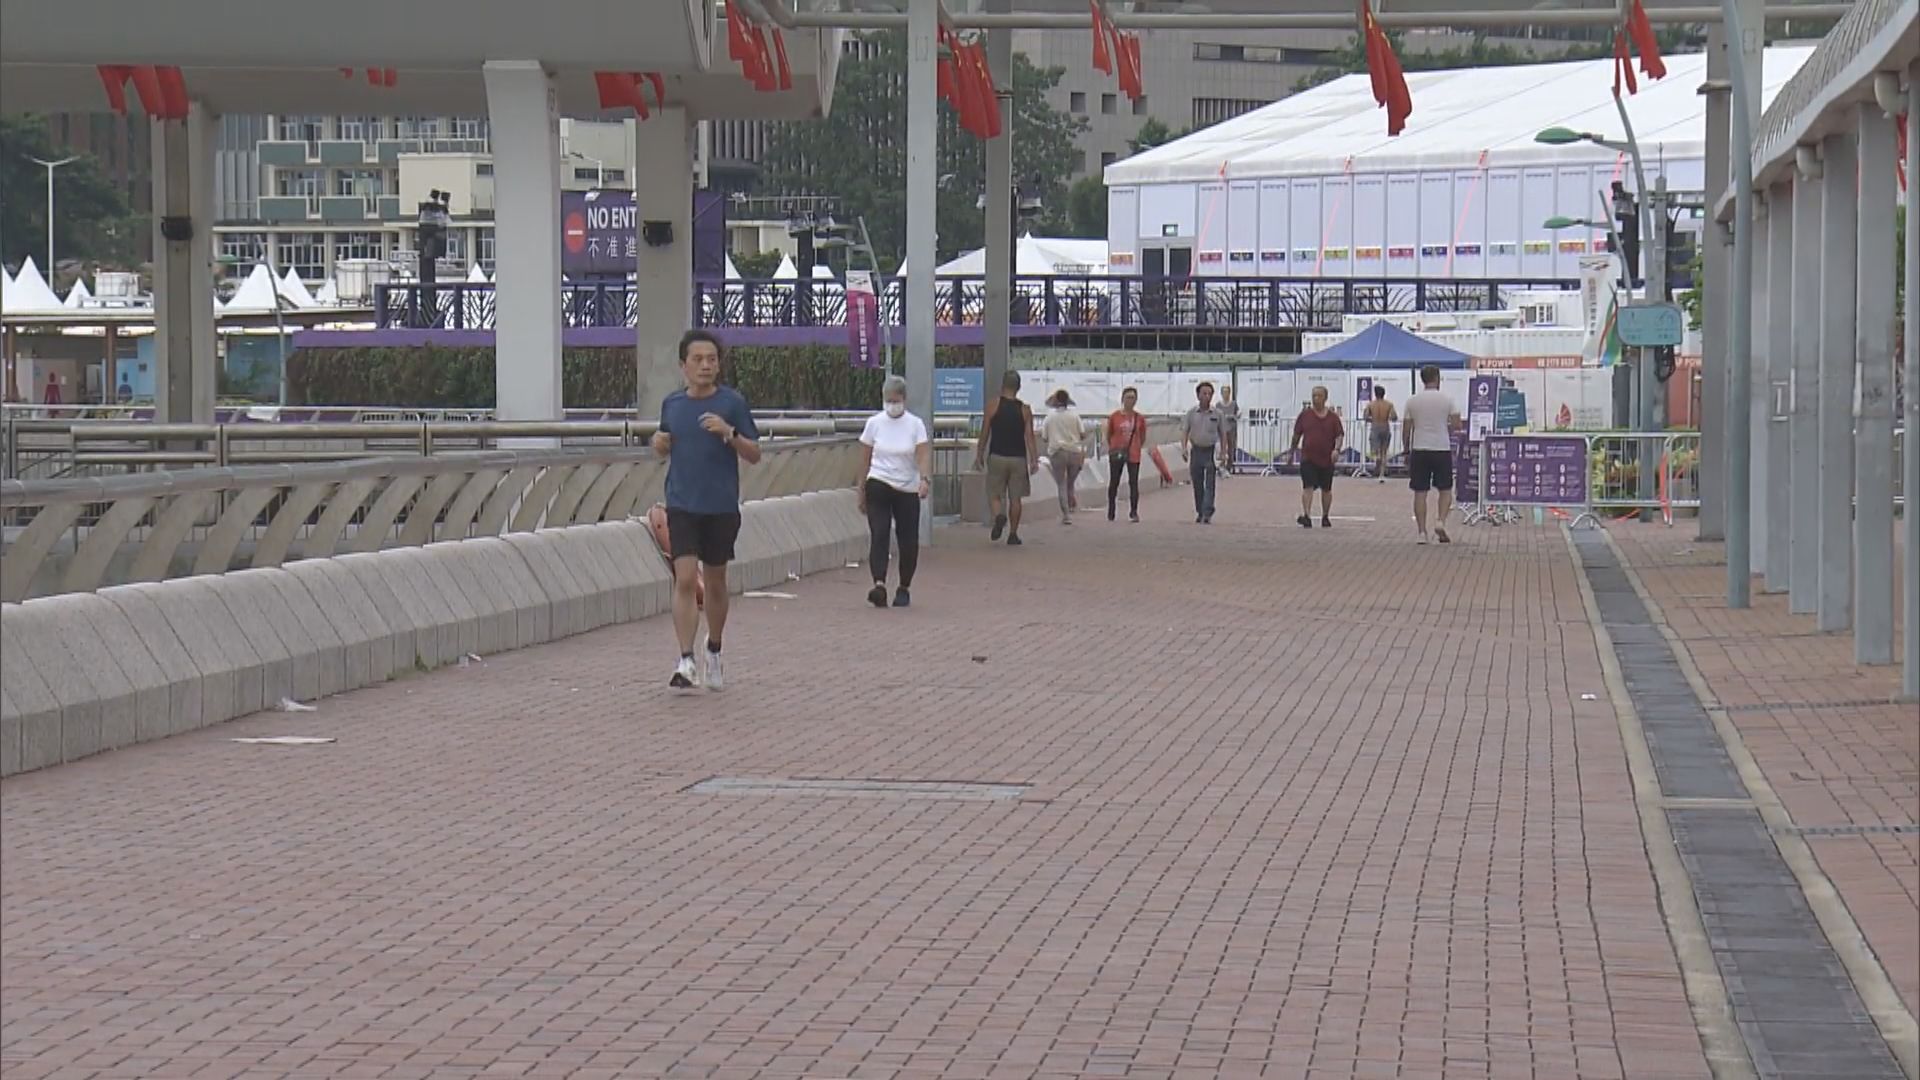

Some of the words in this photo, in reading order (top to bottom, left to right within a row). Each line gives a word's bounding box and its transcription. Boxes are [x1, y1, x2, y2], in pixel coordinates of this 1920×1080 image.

[587, 206, 608, 229] NO
[612, 206, 637, 229] ENT
[588, 235, 637, 258] 不准進
